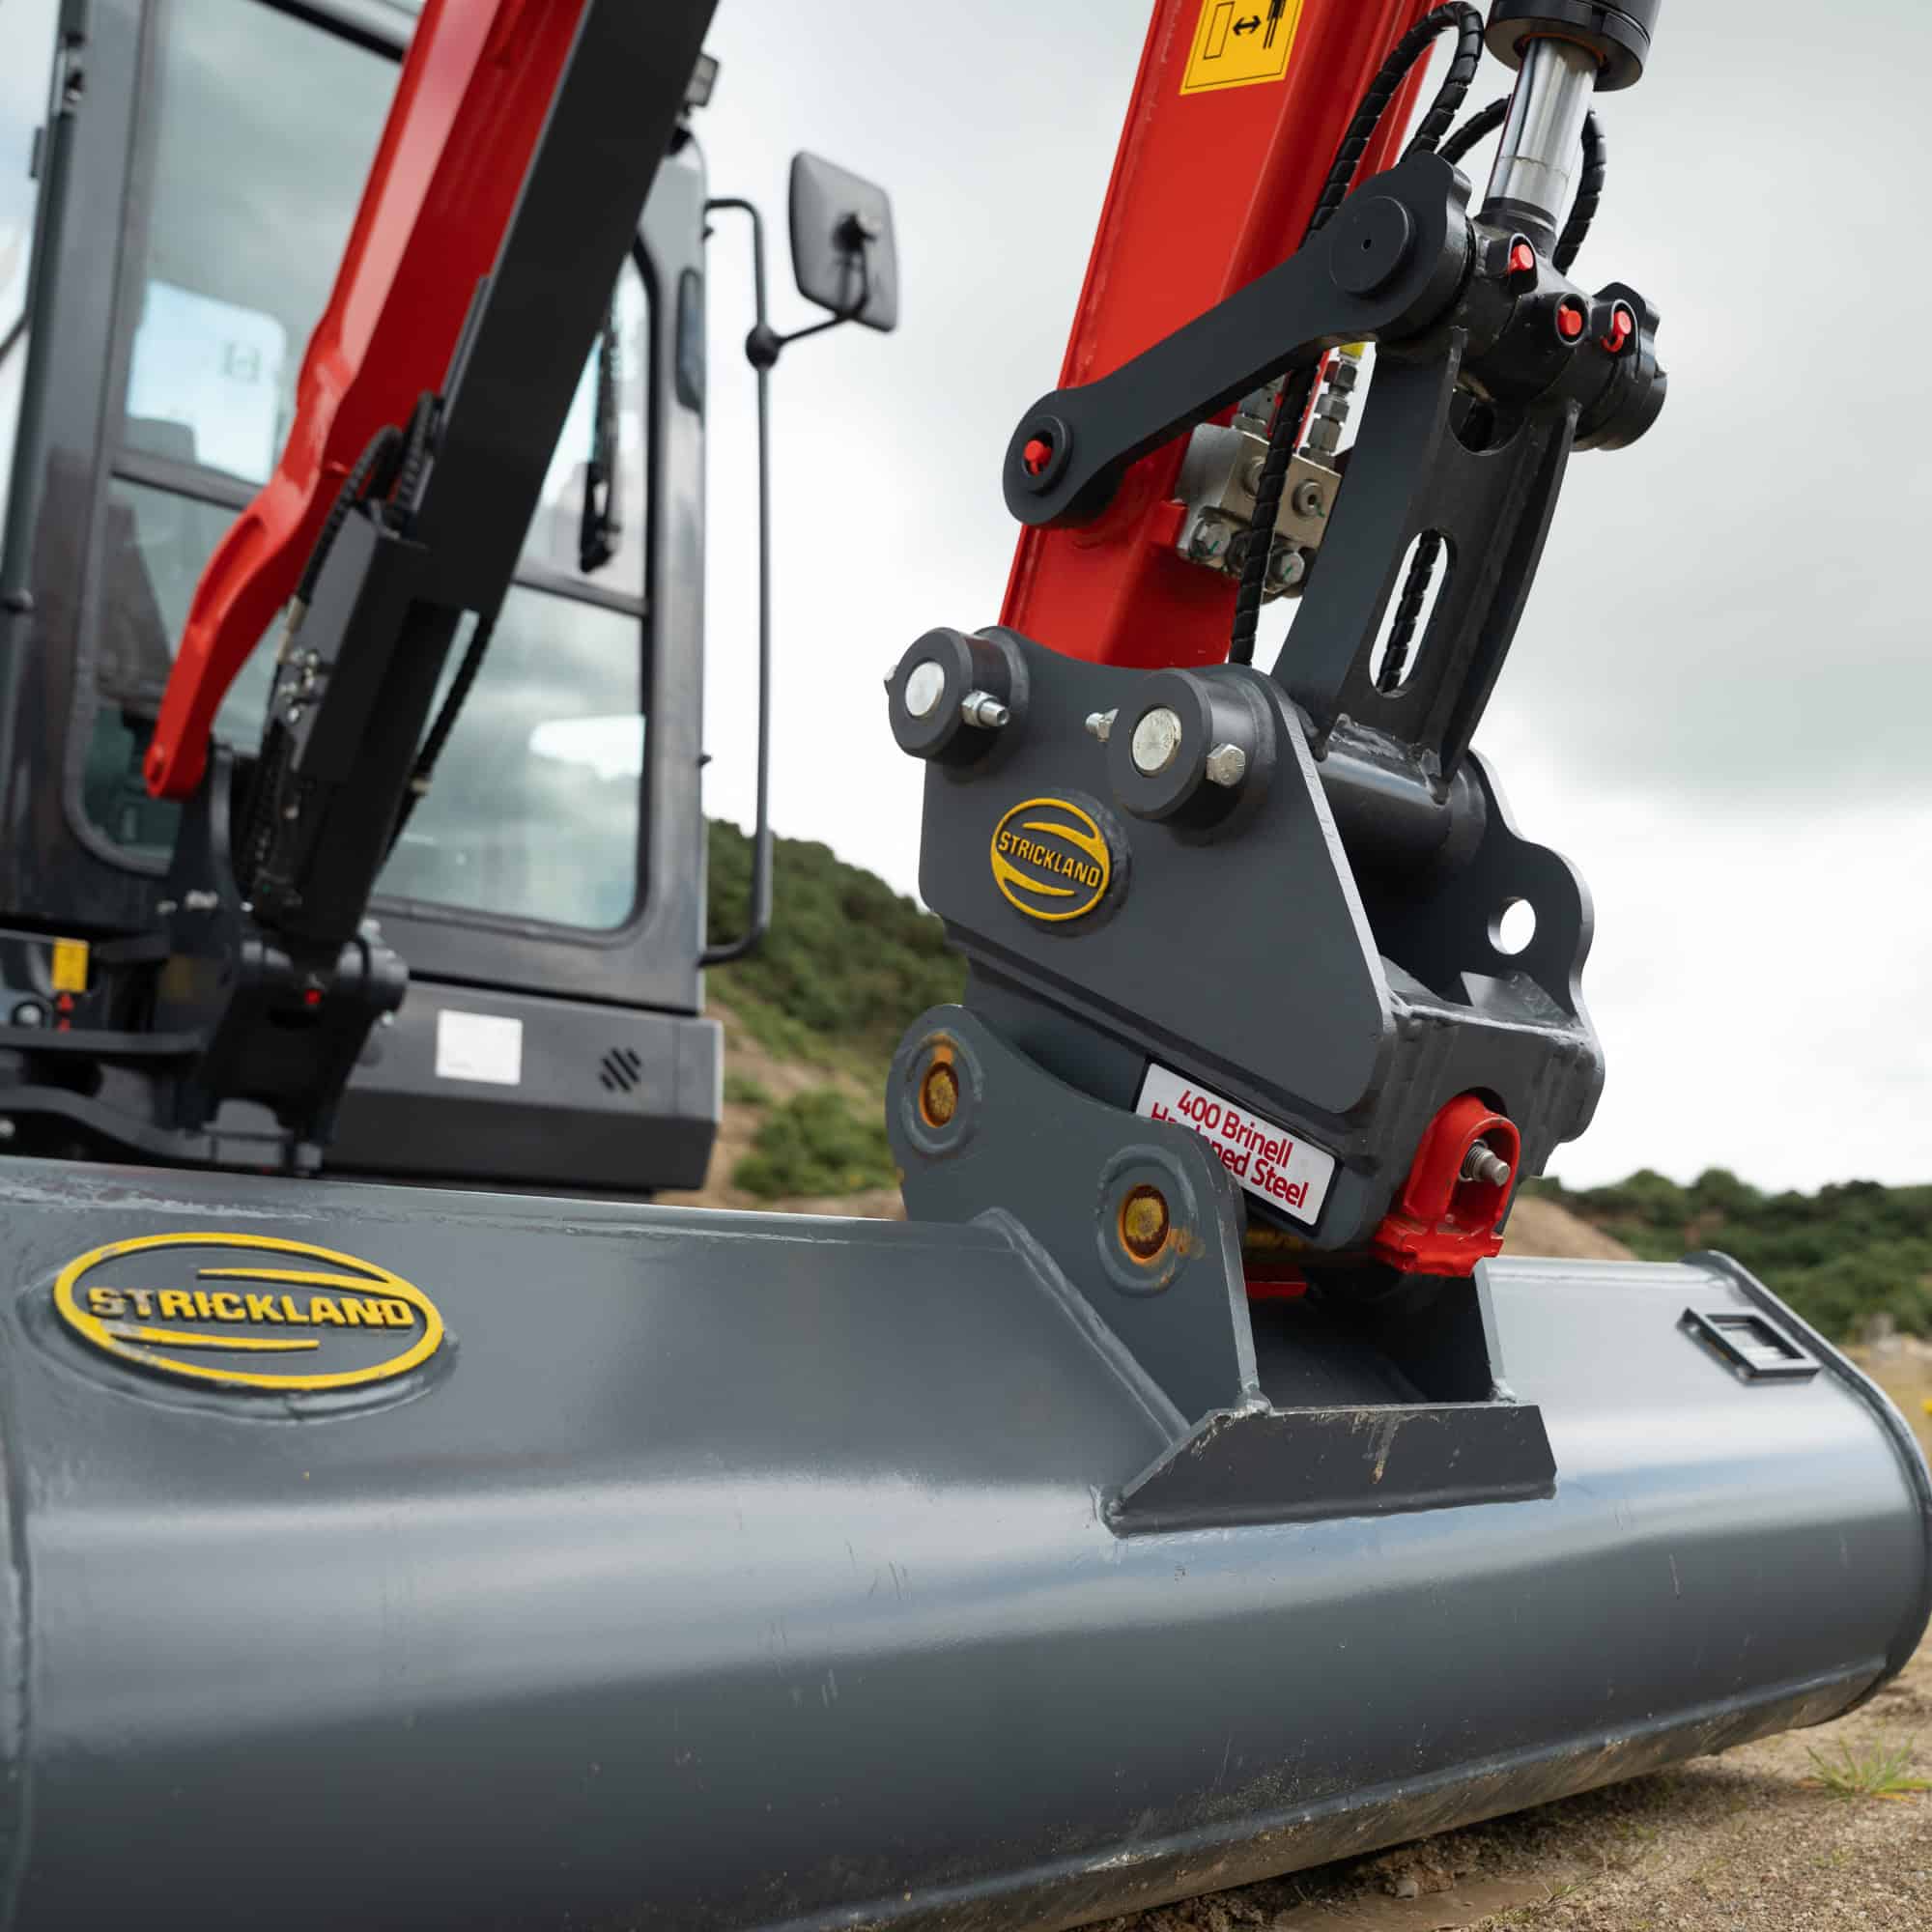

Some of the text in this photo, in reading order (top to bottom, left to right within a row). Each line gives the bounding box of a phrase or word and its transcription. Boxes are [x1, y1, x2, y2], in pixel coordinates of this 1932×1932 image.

[997, 830, 1101, 888] STRICKLAND
[1151, 1101, 1310, 1209] Hned Steel
[1177, 1089, 1294, 1169] 400 Brinell
[87, 1287, 415, 1329] STRICKLAND
